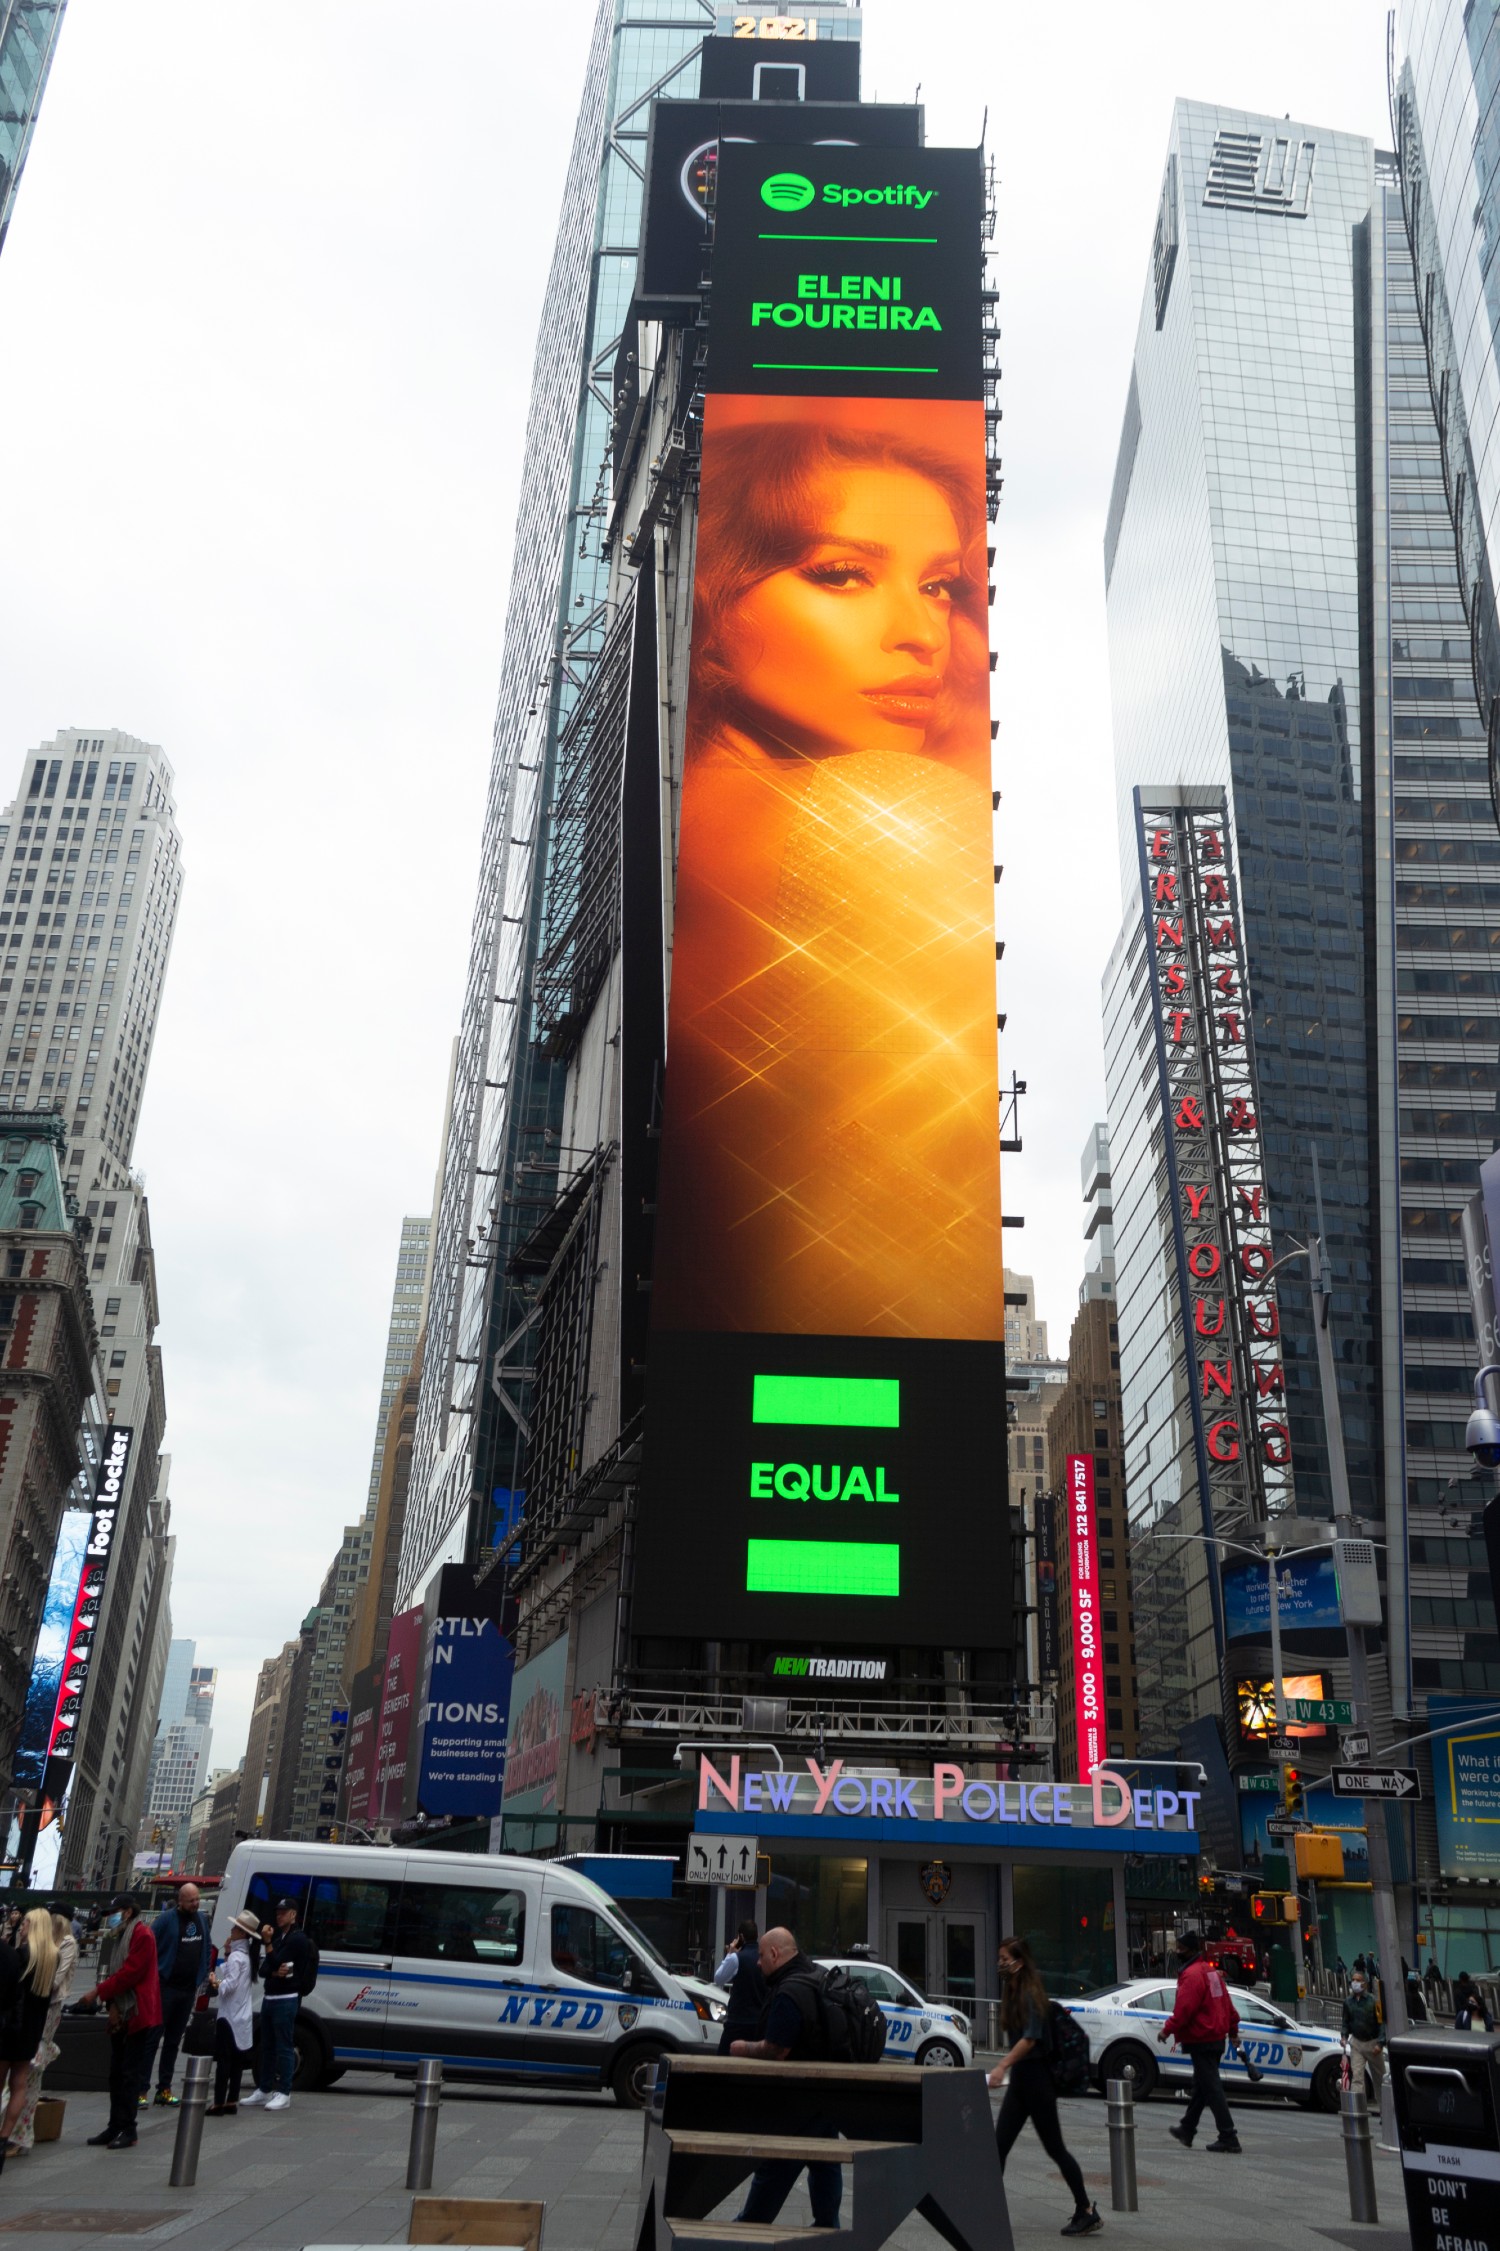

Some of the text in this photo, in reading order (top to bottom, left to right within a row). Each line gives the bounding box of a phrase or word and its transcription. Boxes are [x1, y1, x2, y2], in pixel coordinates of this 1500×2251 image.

[734, 16, 817, 41] 2021
[822, 184, 933, 209] Spotify
[798, 275, 901, 301] ELENI
[751, 303, 942, 331] FOUREIRA
[750, 463, 899, 502] EQUAL
[1152, 830, 1241, 1461] ERNST & YOUNG
[1075, 1460, 1088, 1536] 212 841 7517
[87, 1508, 115, 1556] Foot
[1079, 1588, 1092, 1609] SF
[1293, 1600, 1314, 1608] York
[1080, 1612, 1096, 1658] 9,000
[1083, 1673, 1098, 1720] 3,000
[1299, 1702, 1311, 1719] W
[1319, 1703, 1335, 1720] 43
[1341, 1704, 1350, 1715] St
[432, 1737, 482, 1748] Supporting
[431, 1748, 479, 1758] businesses
[481, 1749, 493, 1758] for
[1458, 1755, 1490, 1768] What
[429, 1772, 454, 1781] We're
[457, 1772, 495, 1783] standing
[1249, 1780, 1256, 1788] W
[1260, 1780, 1270, 1789] 43
[1345, 1776, 1406, 1789] ONE WAY
[1459, 1773, 1489, 1783] were
[700, 1752, 1200, 1831] NEW YORK POLICE DEPT
[1461, 1789, 1489, 1797] Working
[1270, 1823, 1285, 1831] ONE
[1291, 1824, 1307, 1833] WAY
[689, 1871, 752, 1882] ONLY ONLY ONLY
[498, 1995, 604, 2030] NYPD
[653, 1998, 685, 2010] POLICE
[922, 2011, 945, 2019] POLICE
[1437, 2155, 1461, 2165] TRASH
[1427, 2177, 1467, 2199] DON'T
[1431, 2206, 1450, 2226] BE
[1436, 2233, 1489, 2251] AFRAID
